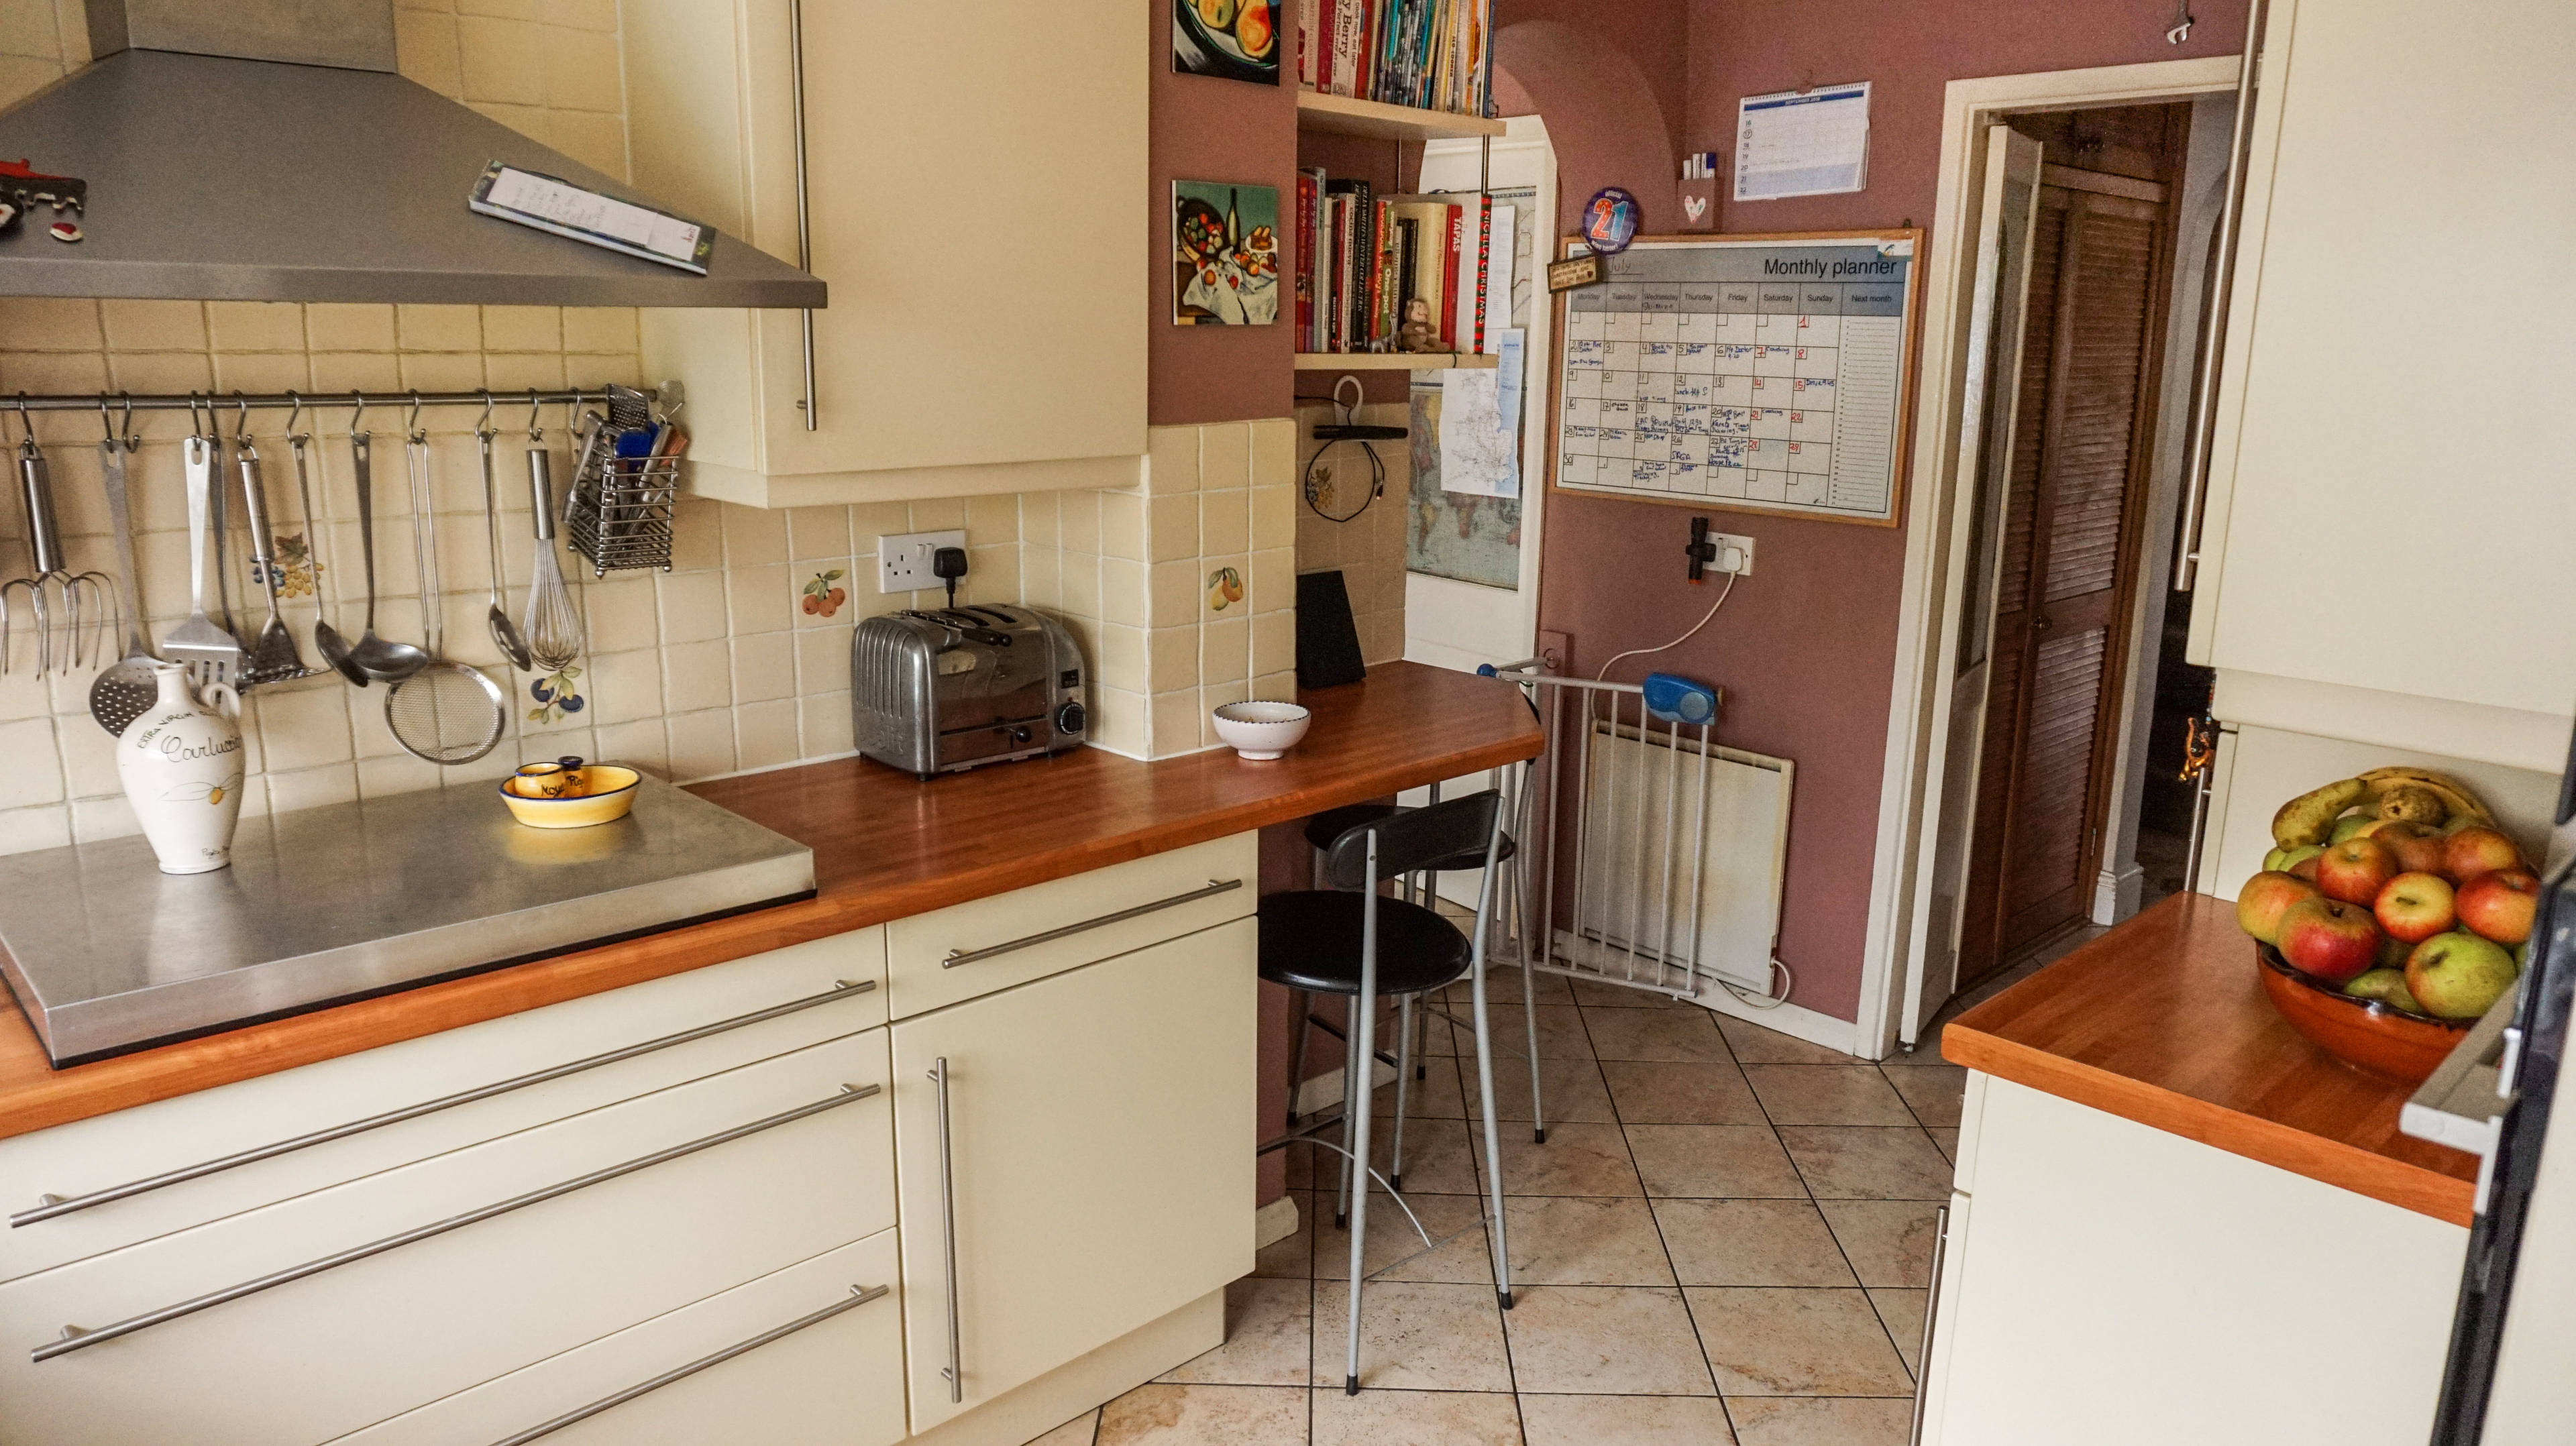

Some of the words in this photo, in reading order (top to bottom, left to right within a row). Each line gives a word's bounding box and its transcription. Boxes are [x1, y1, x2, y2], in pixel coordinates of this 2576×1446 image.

[1339, 13, 1352, 58] Berry
[1591, 198, 1629, 242] 21
[1453, 217, 1462, 252] TAPAS
[1481, 211, 1491, 258] NIGELLA
[1608, 256, 1631, 274] July
[1764, 259, 1827, 278] Monthly
[1833, 259, 1897, 278] planner
[1383, 268, 1391, 314] One-pot
[1479, 262, 1489, 325] CHRISTMAS
[1612, 293, 1636, 301] Tuesday
[1684, 293, 1713, 302] Thursday
[1728, 294, 1748, 302] Friday
[1764, 294, 1793, 302] Saturday
[1807, 294, 1833, 302] Sunday
[1800, 315, 1807, 327] 1
[1570, 341, 1576, 350] 2
[1606, 343, 1611, 352] 3
[1642, 343, 1648, 352] 4
[1678, 344, 1684, 353] 5
[1717, 345, 1724, 354] 6
[1756, 346, 1765, 357] 7
[1798, 349, 1805, 359] 8
[1569, 370, 1574, 379] 9
[1676, 375, 1684, 384] 12
[1715, 376, 1722, 386] 13
[1754, 378, 1762, 387] 14
[1795, 381, 1803, 389] 15
[1603, 402, 1609, 410] 17
[1638, 402, 1645, 411] 18
[1674, 404, 1682, 412] 19
[1712, 408, 1722, 416] 20
[1752, 410, 1758, 419] 21
[1791, 413, 1802, 421] 22
[1566, 427, 1572, 435] 23
[1711, 437, 1719, 446] 27
[1789, 443, 1799, 451] 29
[1564, 455, 1572, 464] 30
[137, 728, 162, 749] EXTRA
[158, 711, 195, 726] VIRGIN
